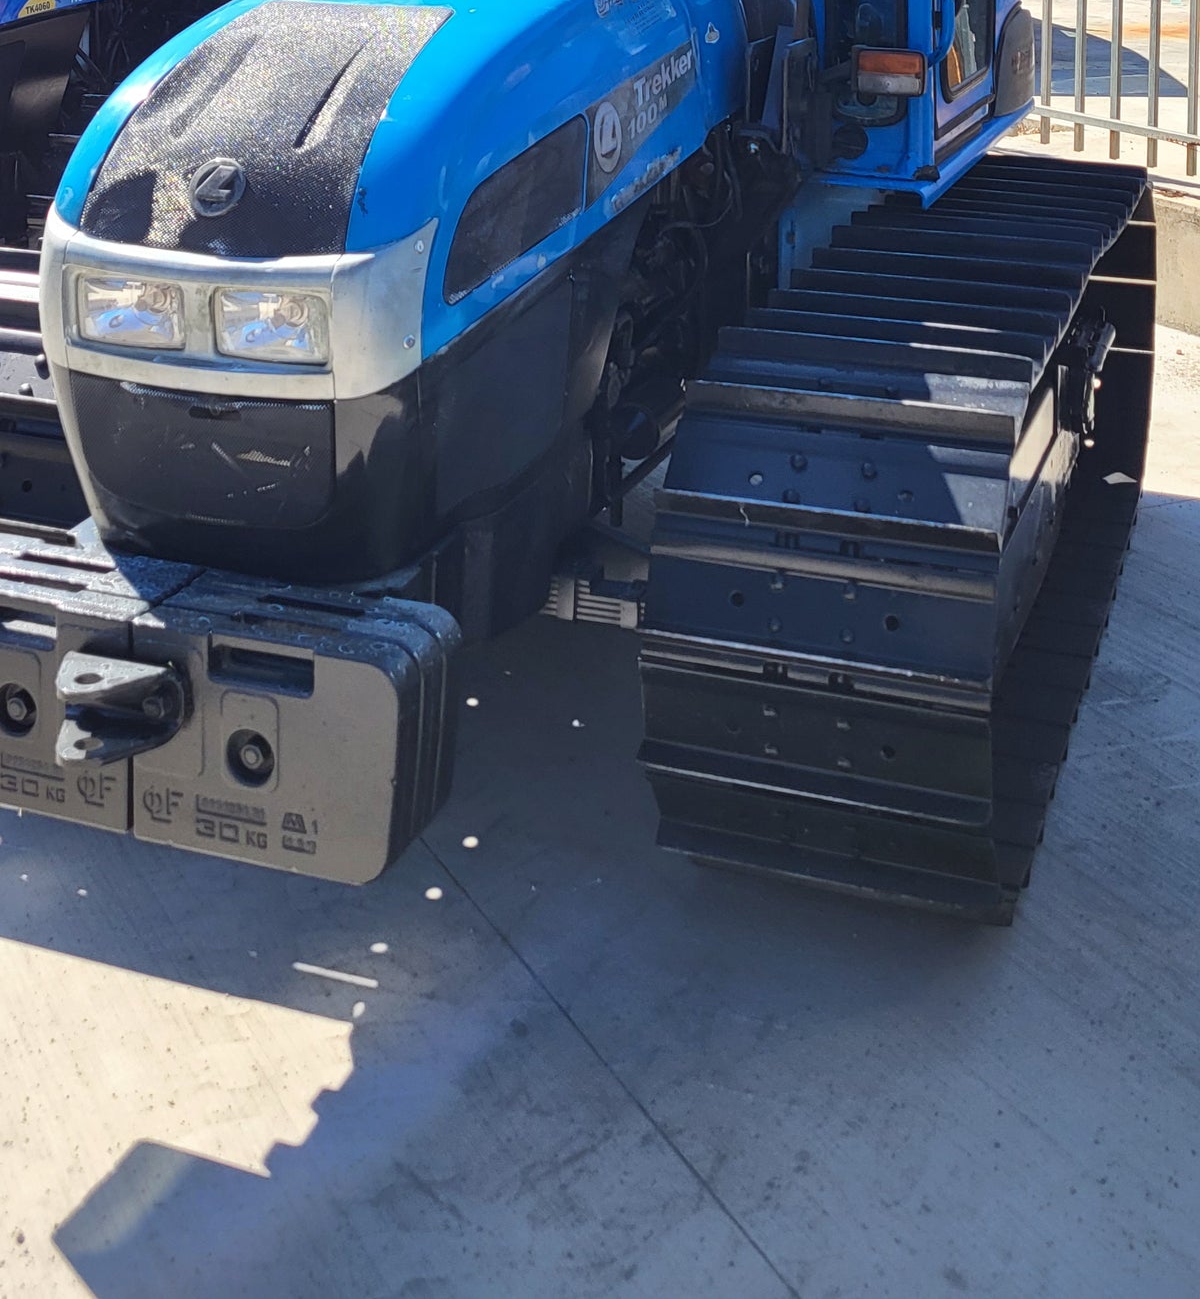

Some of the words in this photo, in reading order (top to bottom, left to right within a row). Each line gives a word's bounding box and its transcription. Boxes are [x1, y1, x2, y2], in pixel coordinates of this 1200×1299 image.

[25, 1, 51, 16] TK4060
[633, 48, 693, 107] Trekker
[627, 103, 658, 140] 100
[196, 817, 240, 844] 30
[245, 829, 268, 850] KG
